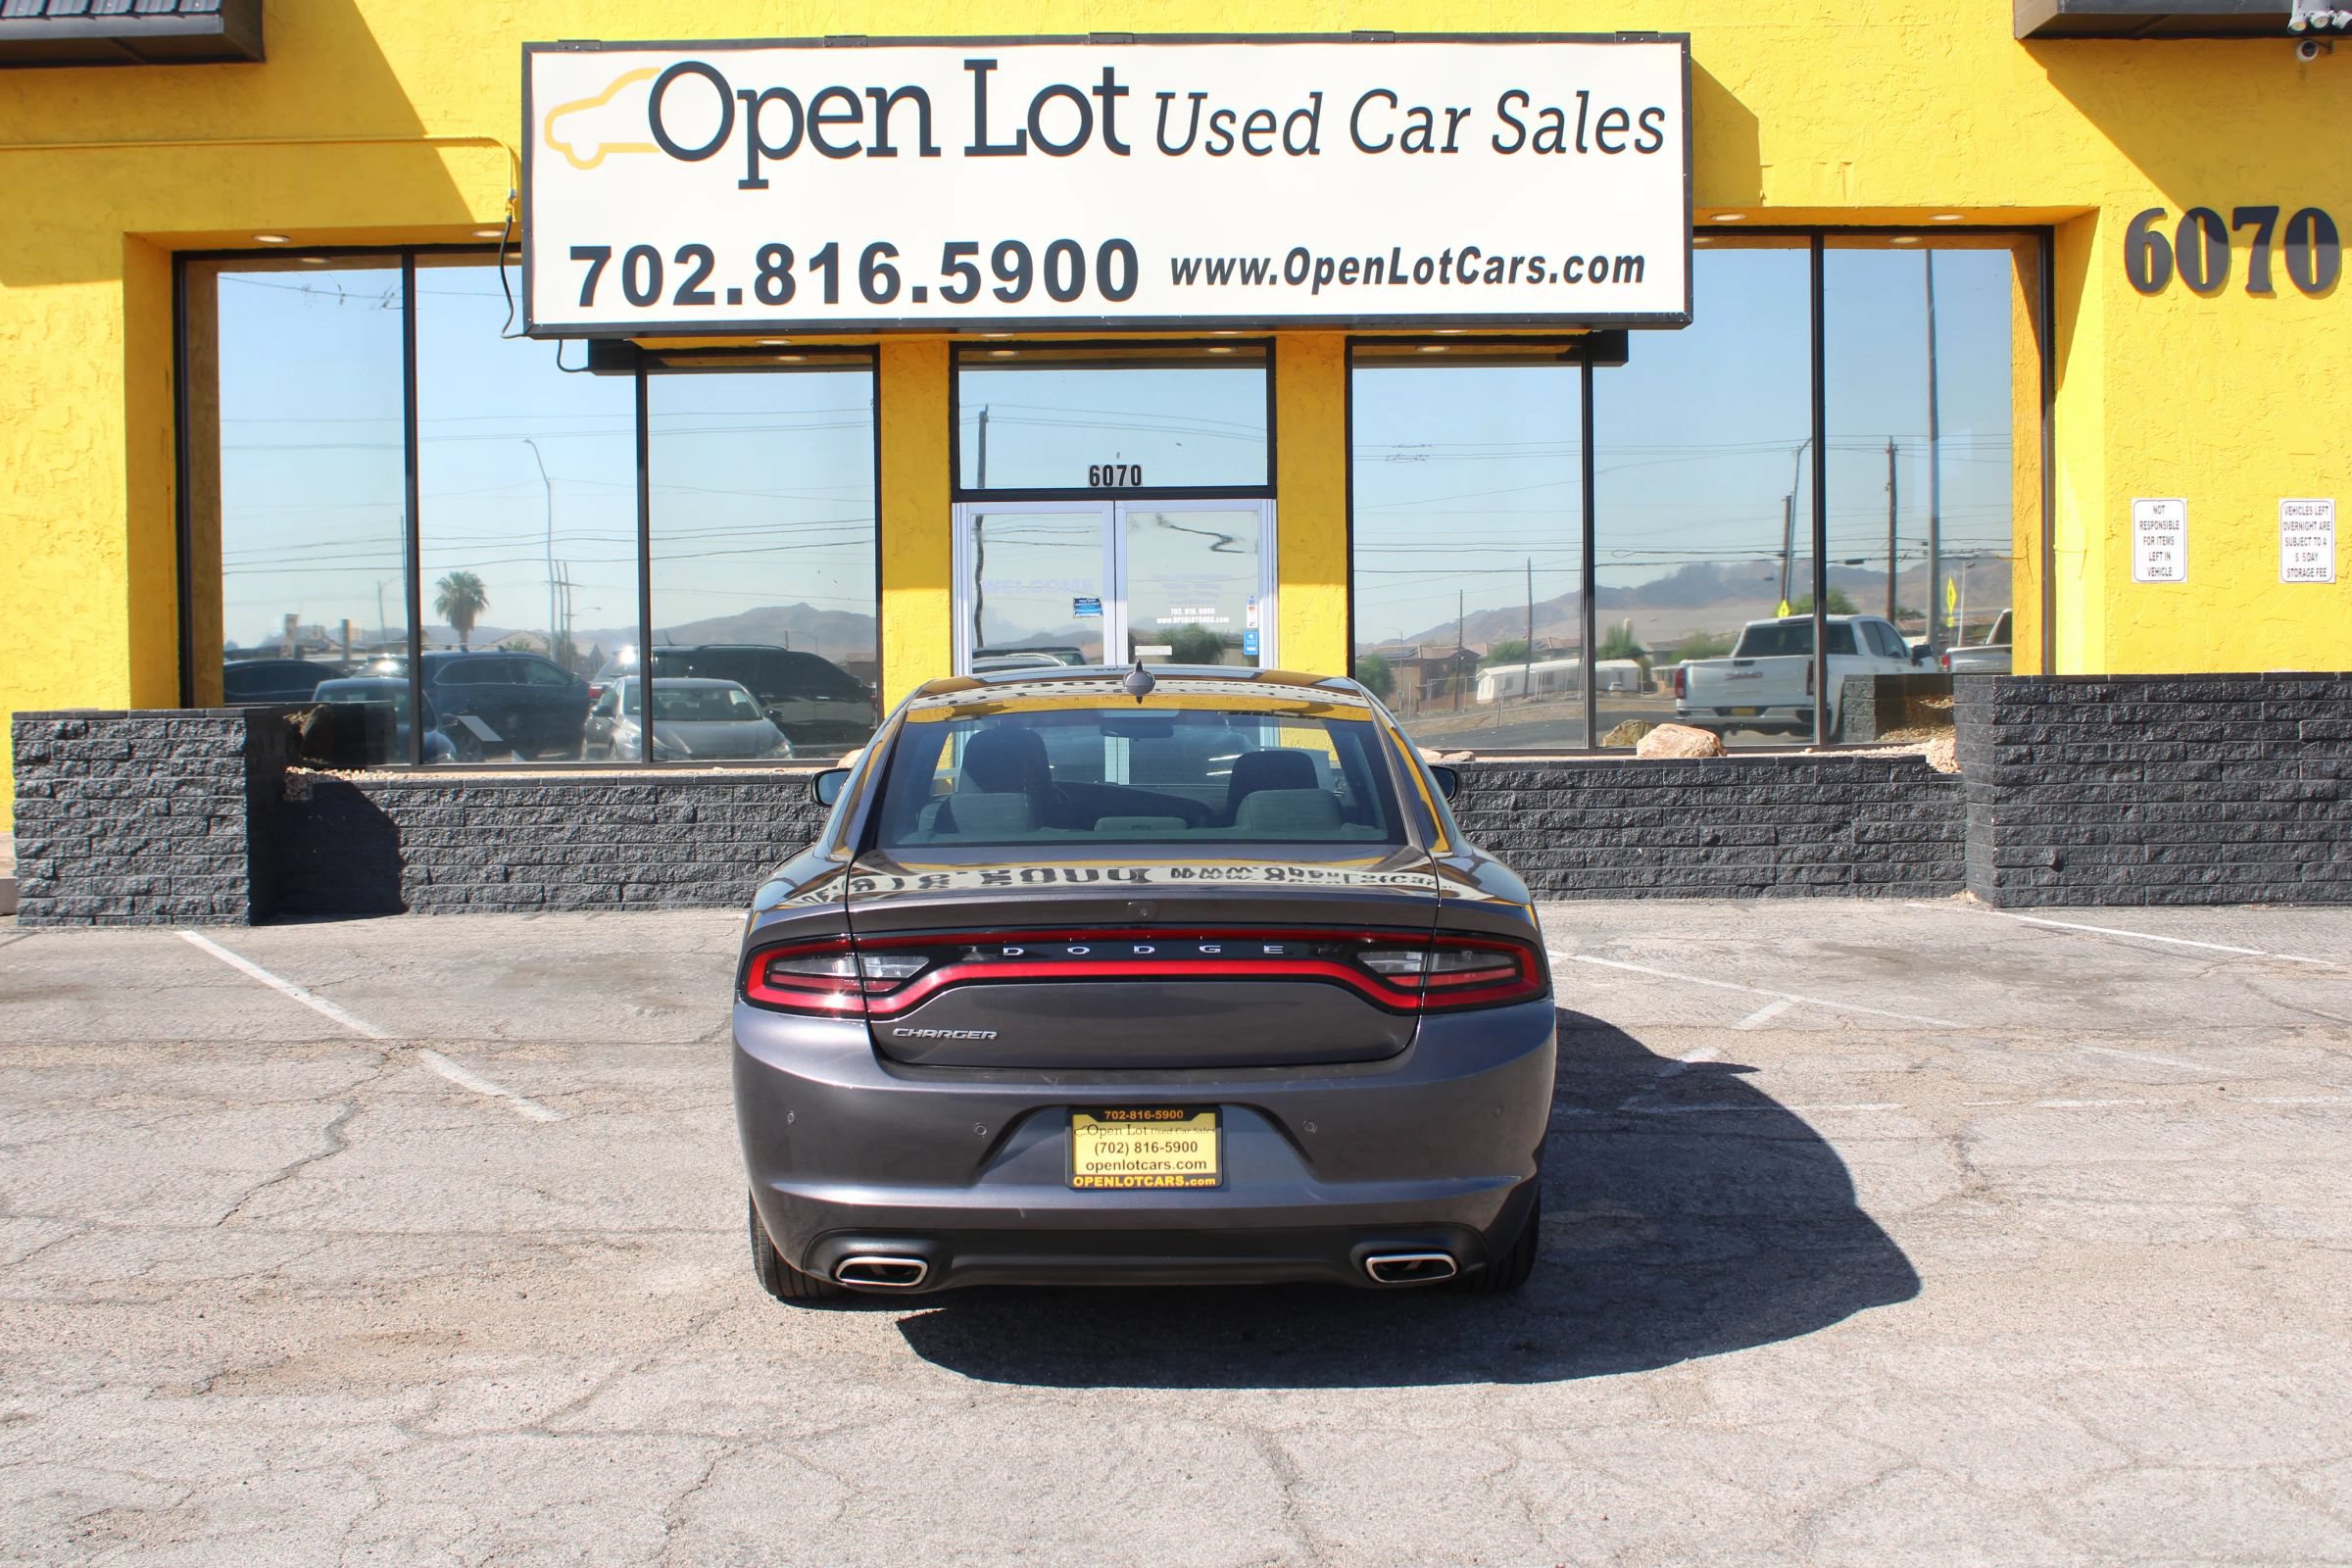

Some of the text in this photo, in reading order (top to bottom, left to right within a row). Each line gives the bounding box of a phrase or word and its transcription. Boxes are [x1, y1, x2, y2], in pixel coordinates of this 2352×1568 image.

[649, 59, 1666, 190] Open Lot Used Car Sales
[2125, 206, 2340, 294] 6070
[569, 238, 1645, 308] 702.816.5900 www.OpenLotCars.com
[1089, 464, 1143, 487] 6070
[2152, 505, 2166, 515] NOT
[2284, 506, 2329, 516] VEHICLES LEFT
[2138, 519, 2180, 530] RESPONSIBLE
[2283, 521, 2330, 531] OVERNIGHT ARE
[2143, 535, 2175, 546] FOR ITEMS
[2284, 537, 2312, 547] SUBJECT
[2314, 537, 2322, 547] TO
[2148, 551, 2171, 562] LEFT IN
[2147, 566, 2173, 577] VEHICLE
[2286, 567, 2328, 578] STORAGE FEE
[1003, 945, 1284, 956] DODGE
[892, 1027, 998, 1040] CHARGER
[1104, 1109, 1184, 1120] 702-816-5900
[1087, 1123, 1123, 1139] Open
[1127, 1123, 1148, 1136] Lot
[1095, 1141, 1199, 1156] (702) 816-5900
[1086, 1158, 1207, 1173] openlotcars.com
[1073, 1175, 1216, 1188] OPENLOTCARS.com
